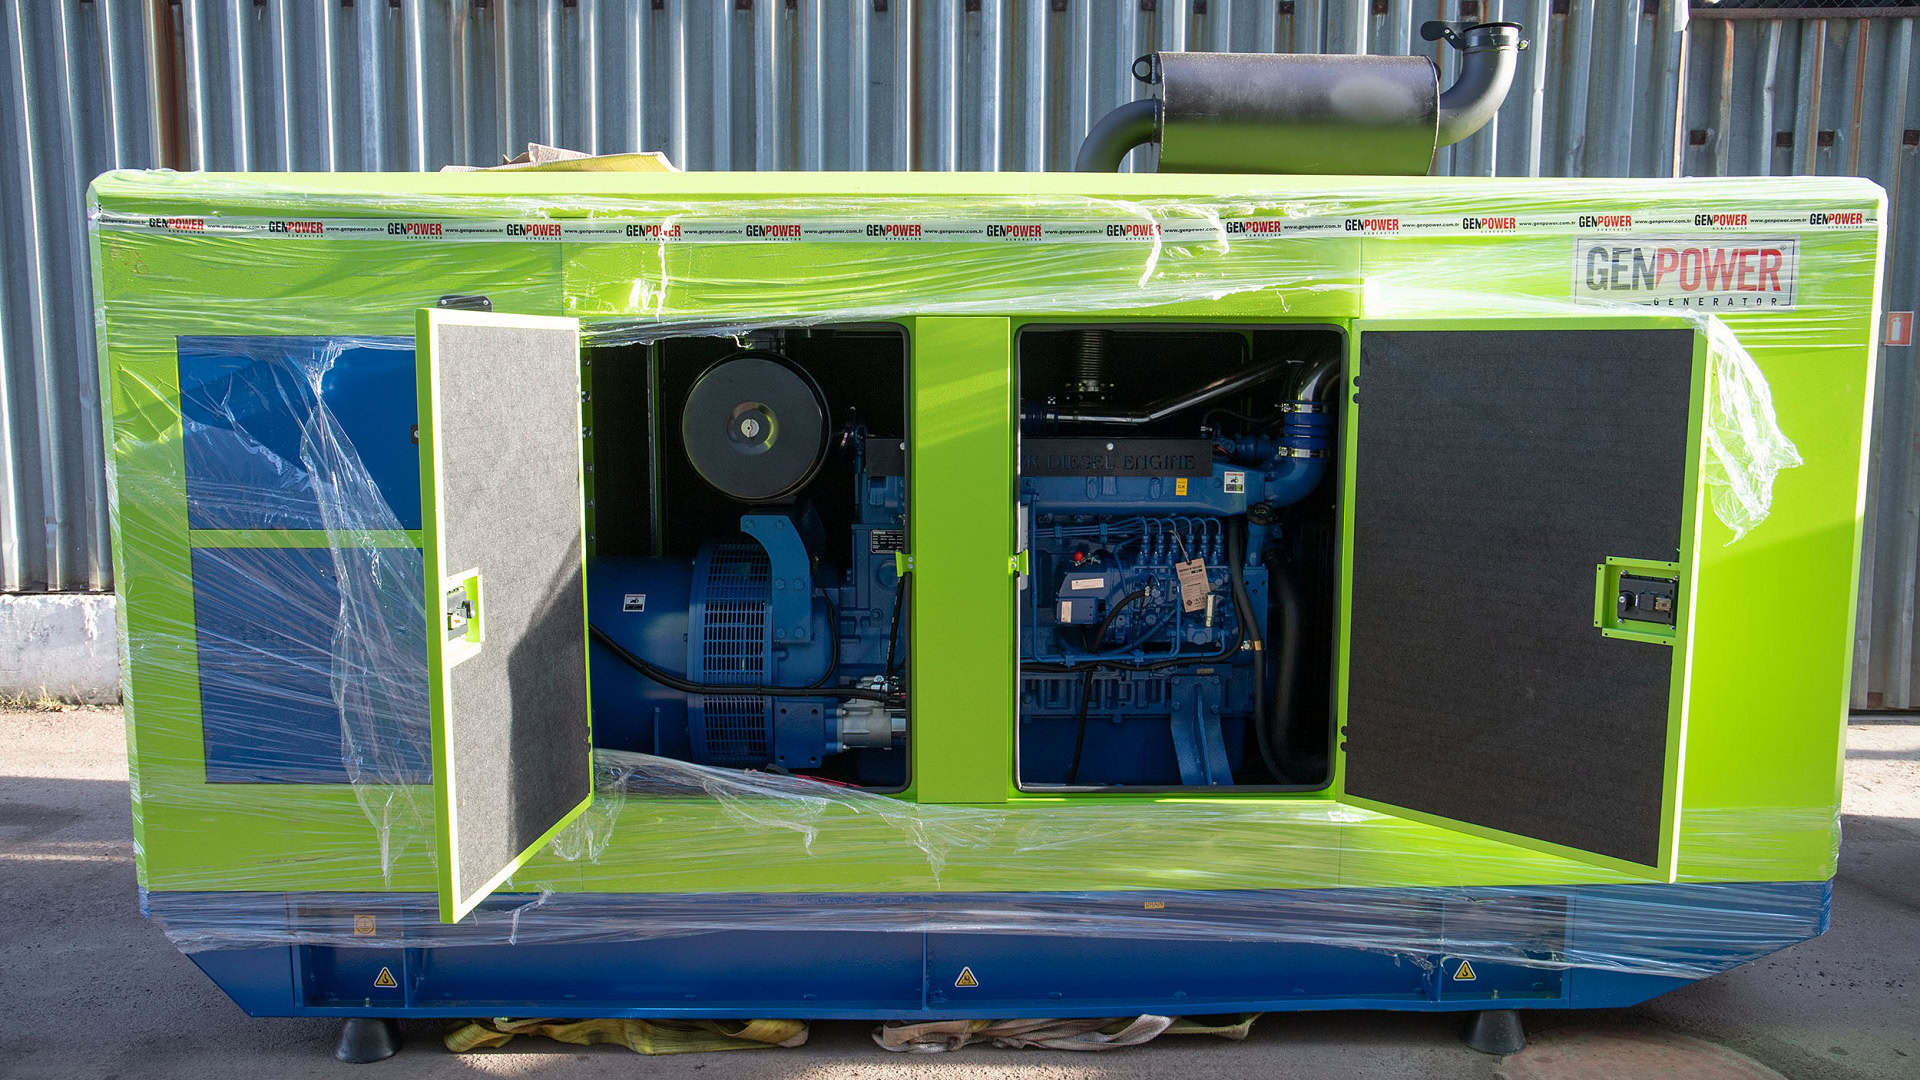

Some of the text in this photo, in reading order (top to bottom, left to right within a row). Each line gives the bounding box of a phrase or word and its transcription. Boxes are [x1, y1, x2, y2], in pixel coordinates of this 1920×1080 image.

[149, 218, 204, 230] GENPOWER
[269, 221, 324, 234] GENPOWER
[387, 222, 443, 235] GENPOWER
[506, 224, 562, 237] GENPOWER
[626, 224, 681, 237] GENPOER
[746, 224, 801, 237] GENPOWER
[866, 224, 922, 237] GENPOWER
[986, 224, 1042, 237] GENPOWER
[1226, 221, 1281, 234] GENPOWER
[1284, 223, 1342, 231] www.genpower.com.tr
[1345, 218, 1400, 231] GENPOWER
[1462, 217, 1516, 230] GENPOWER
[1518, 220, 1576, 228] www.genpower.com.tr
[1579, 215, 1632, 228] GENPOWER
[1635, 218, 1692, 226] www.genpower.com.tr
[1694, 213, 1748, 226] GENPOWER
[1809, 213, 1863, 226] GENPOWER
[1586, 246, 1783, 291] GENPOWER
[1653, 297, 1777, 306] GENERATOR
[1047, 454, 1116, 470] DIESEL
[1124, 454, 1195, 470] ENGINE
